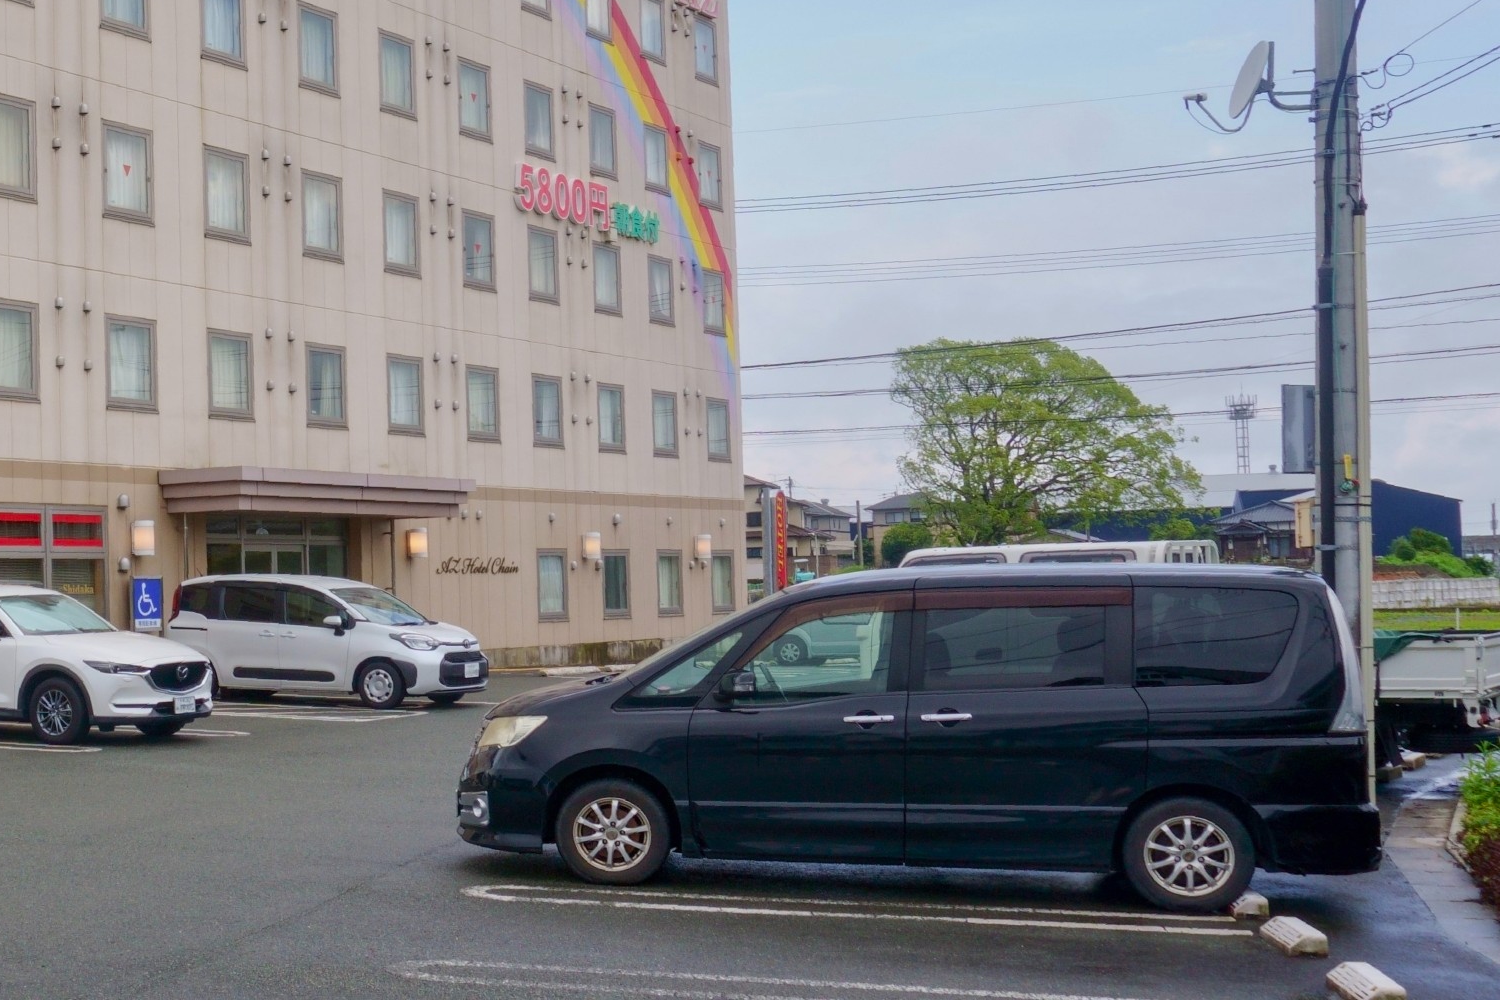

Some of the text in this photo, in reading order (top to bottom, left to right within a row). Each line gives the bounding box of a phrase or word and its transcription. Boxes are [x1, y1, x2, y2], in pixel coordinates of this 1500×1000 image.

[516, 163, 661, 244] 5800円 朝食付
[436, 557, 519, 575] AZ Hotel Chain
